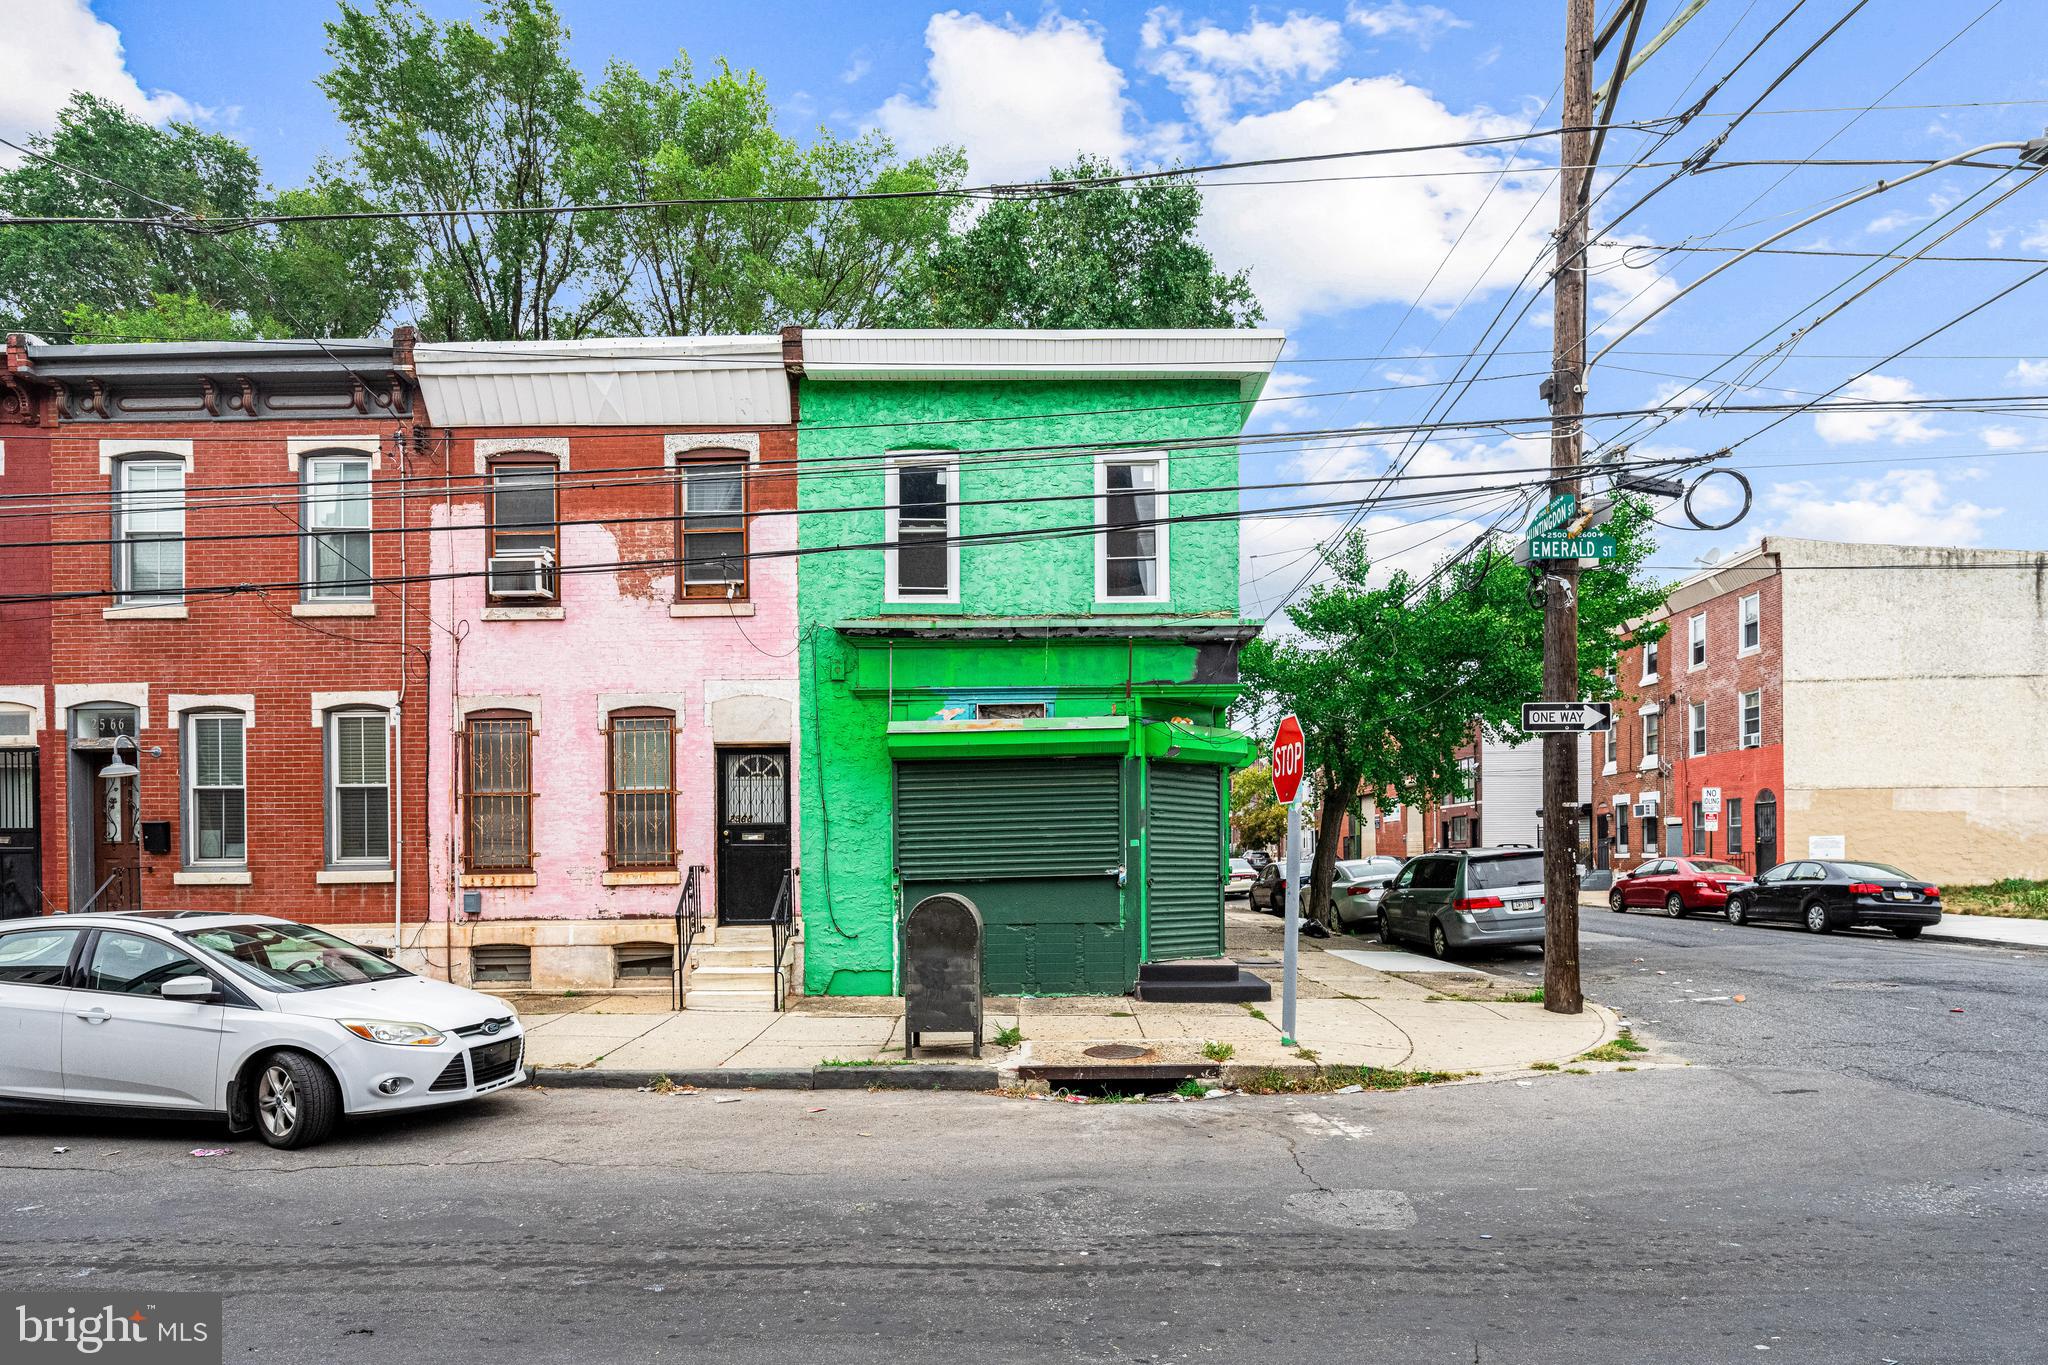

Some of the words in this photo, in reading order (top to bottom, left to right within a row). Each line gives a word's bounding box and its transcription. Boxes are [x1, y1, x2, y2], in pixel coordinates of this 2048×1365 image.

[1526, 503, 1566, 540] HUNTINGDON
[1567, 502, 1574, 516] ST
[1531, 541, 1595, 557] EMERALD
[1602, 545, 1613, 557] ST
[1532, 711, 1556, 723] ONE
[1560, 711, 1584, 723] WAY
[91, 718, 124, 731] 2566
[1274, 741, 1302, 778] STOP
[1706, 789, 1717, 797] NO
[1703, 797, 1720, 805] DLING
